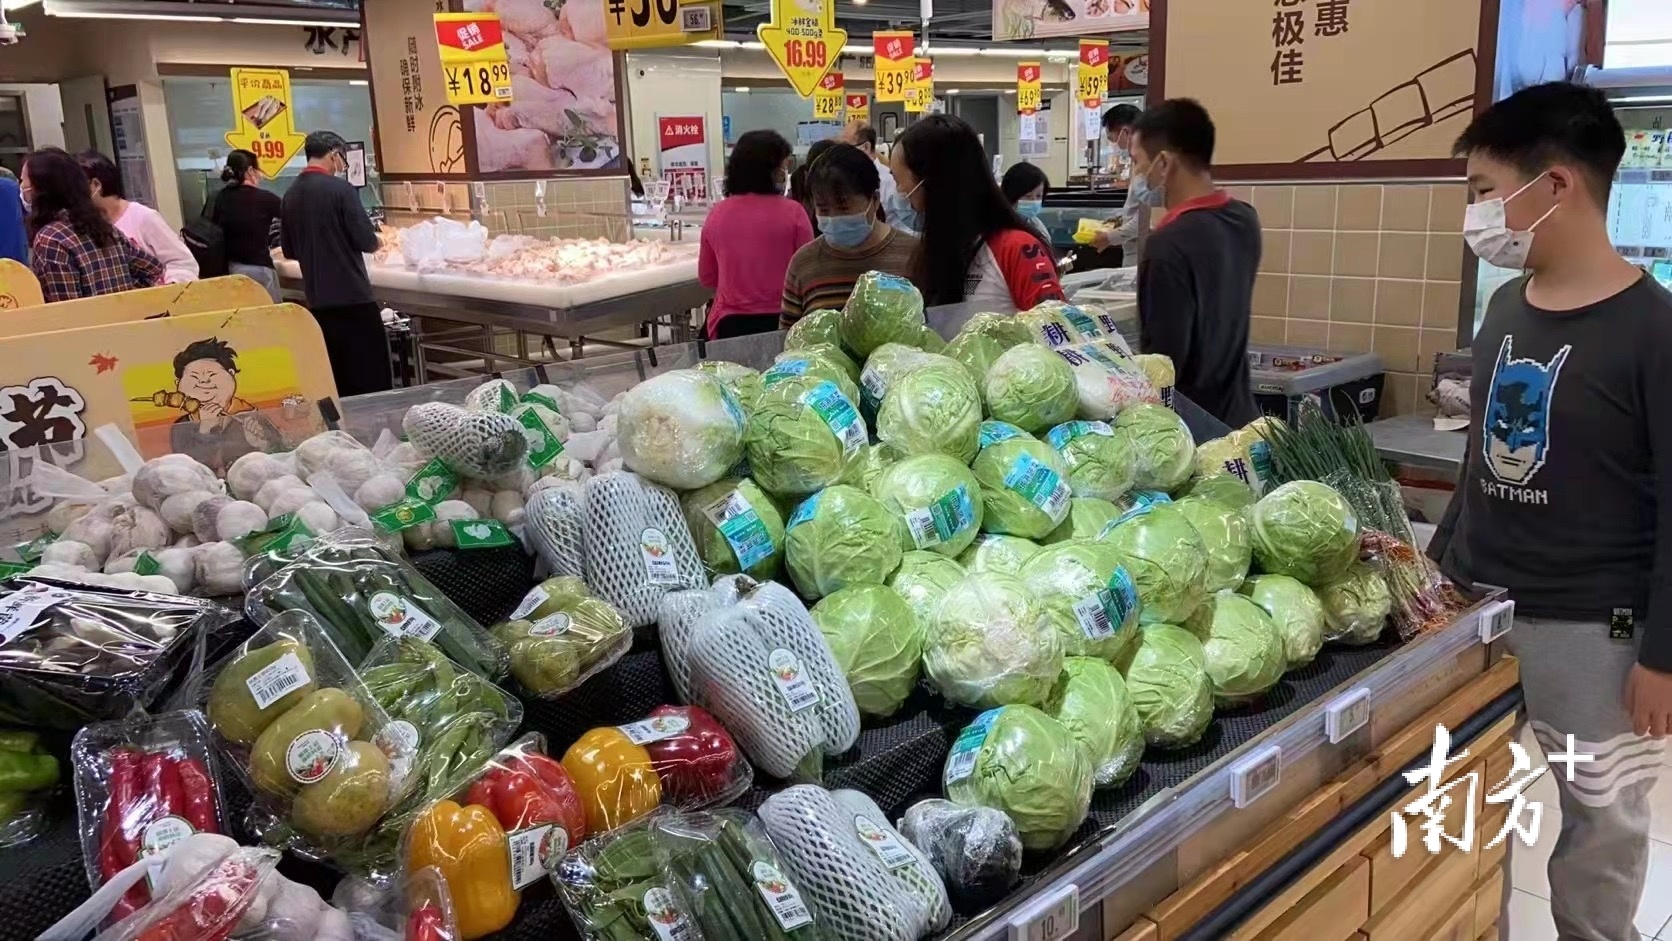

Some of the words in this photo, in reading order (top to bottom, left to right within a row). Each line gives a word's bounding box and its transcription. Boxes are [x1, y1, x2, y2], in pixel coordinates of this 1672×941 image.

[1314, 0, 1350, 36] 惠
[784, 39, 827, 68] 16.99
[1270, 0, 1306, 85] 极佳
[675, 124, 699, 135] 消火栓
[252, 140, 285, 159] 9.99
[1480, 478, 1548, 504] BATMAN
